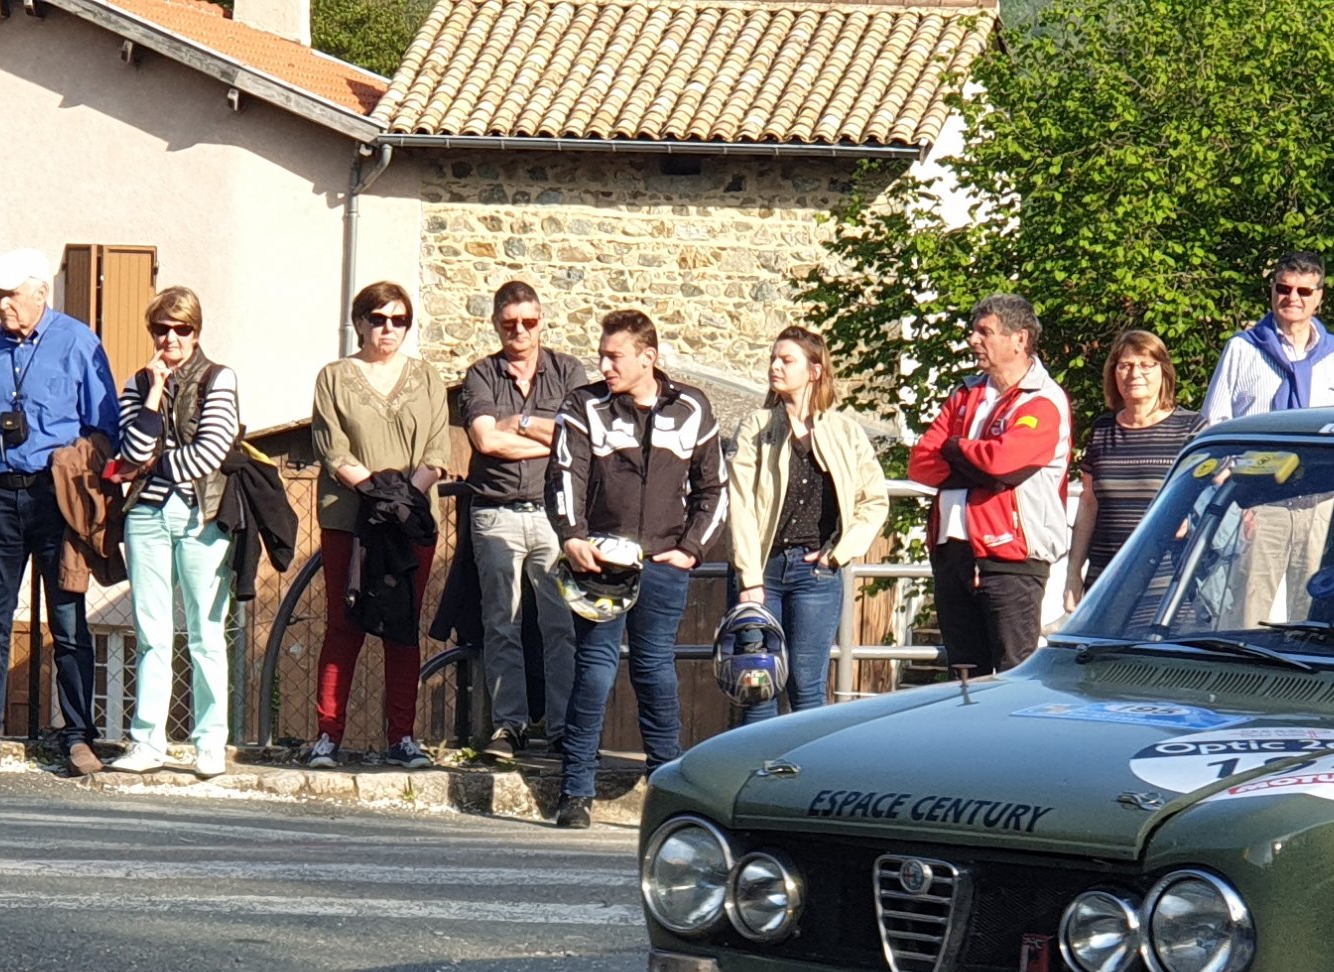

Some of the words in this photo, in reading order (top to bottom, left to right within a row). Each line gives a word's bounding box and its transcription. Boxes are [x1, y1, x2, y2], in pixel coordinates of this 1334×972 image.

[1155, 738, 1286, 755] Optic
[808, 789, 912, 819] ESPACE
[910, 795, 1054, 833] CENTURY
